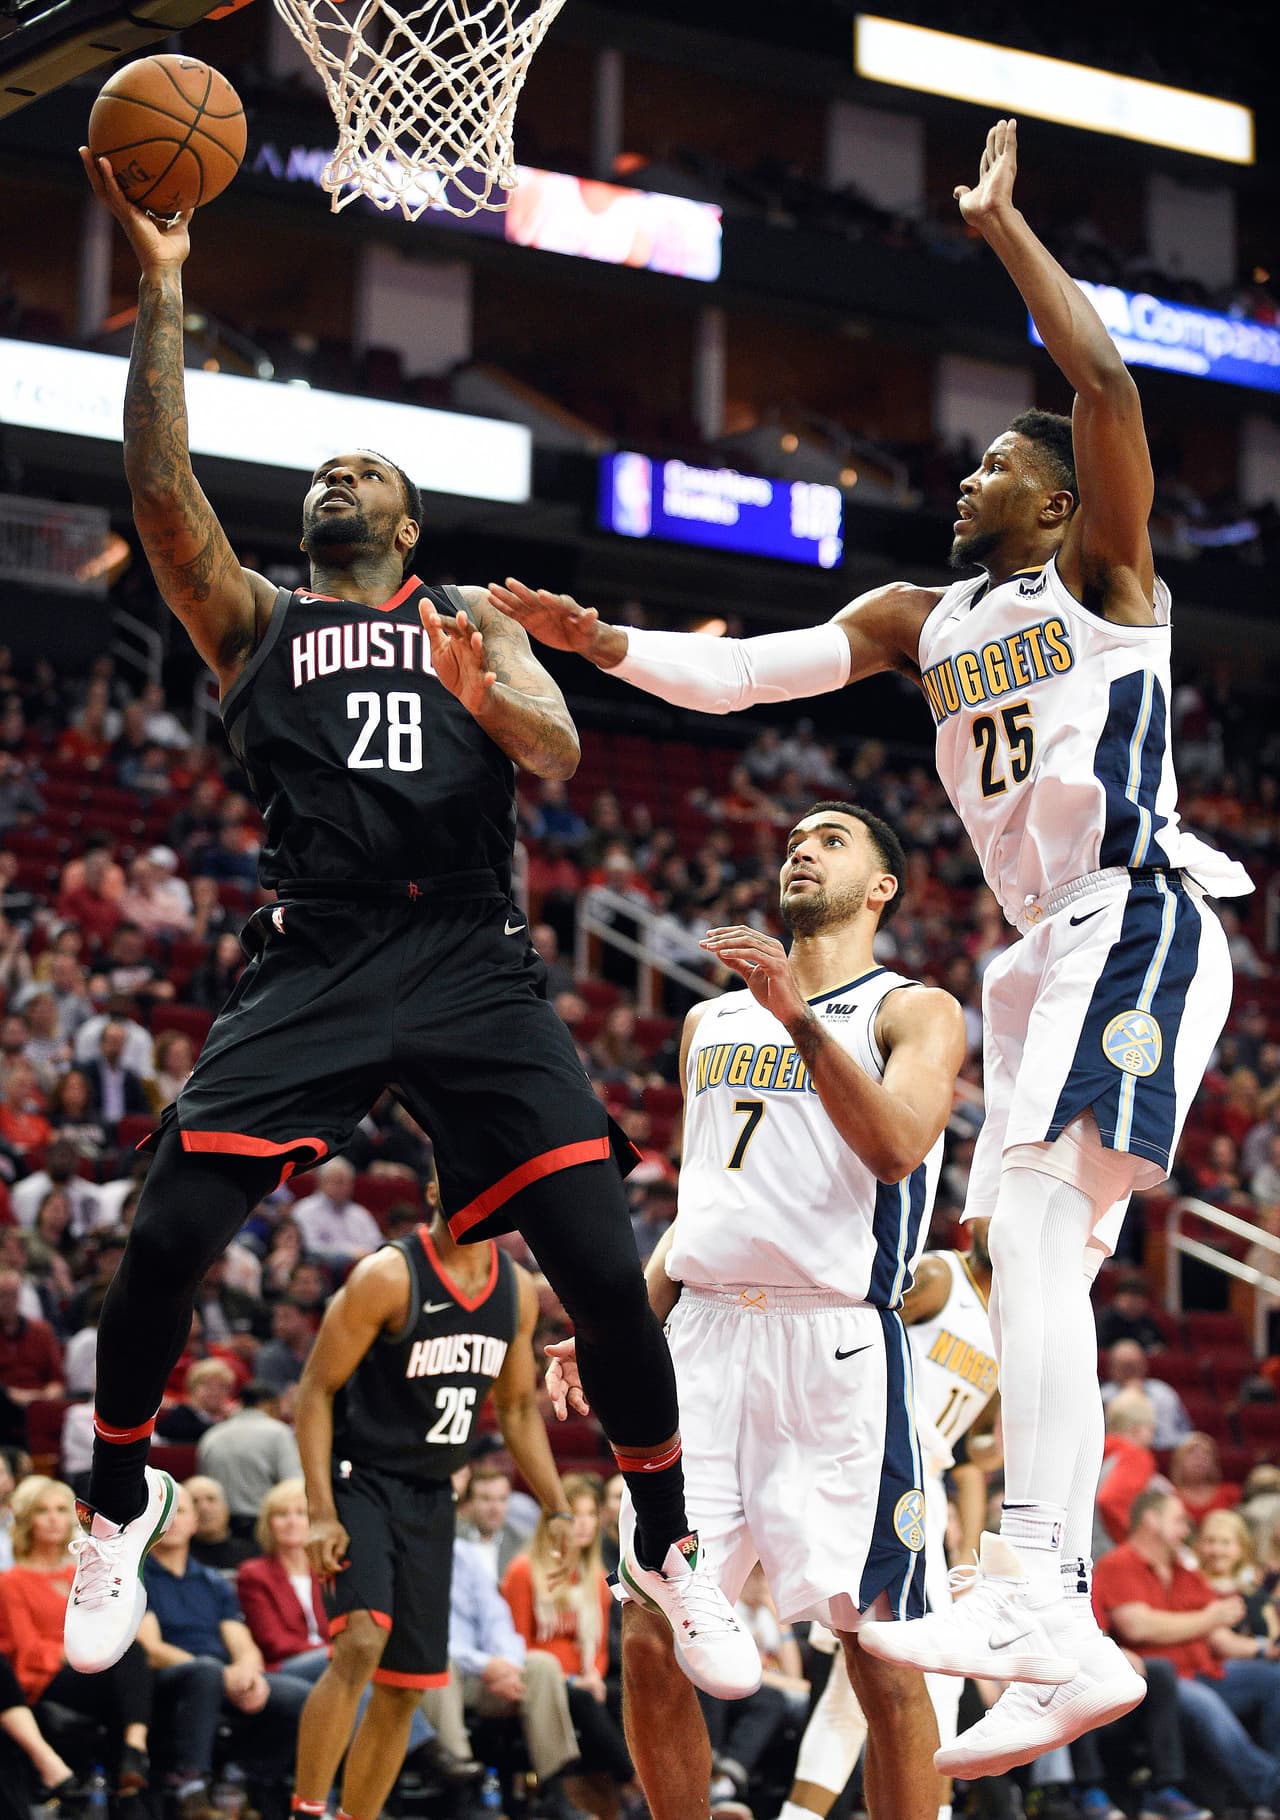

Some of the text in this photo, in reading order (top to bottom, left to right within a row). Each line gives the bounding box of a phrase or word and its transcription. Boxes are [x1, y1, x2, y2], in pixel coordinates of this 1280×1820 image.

[292, 621, 439, 688] HOUST
[921, 616, 1075, 726] NUGGETS
[346, 691, 423, 772] 28
[970, 698, 1036, 800] 25
[695, 1043, 819, 1097] NUGGE
[725, 1098, 766, 1171] 7
[405, 1334, 508, 1379] HOUSTON
[425, 1386, 477, 1445] 26
[935, 1386, 971, 1438] 11
